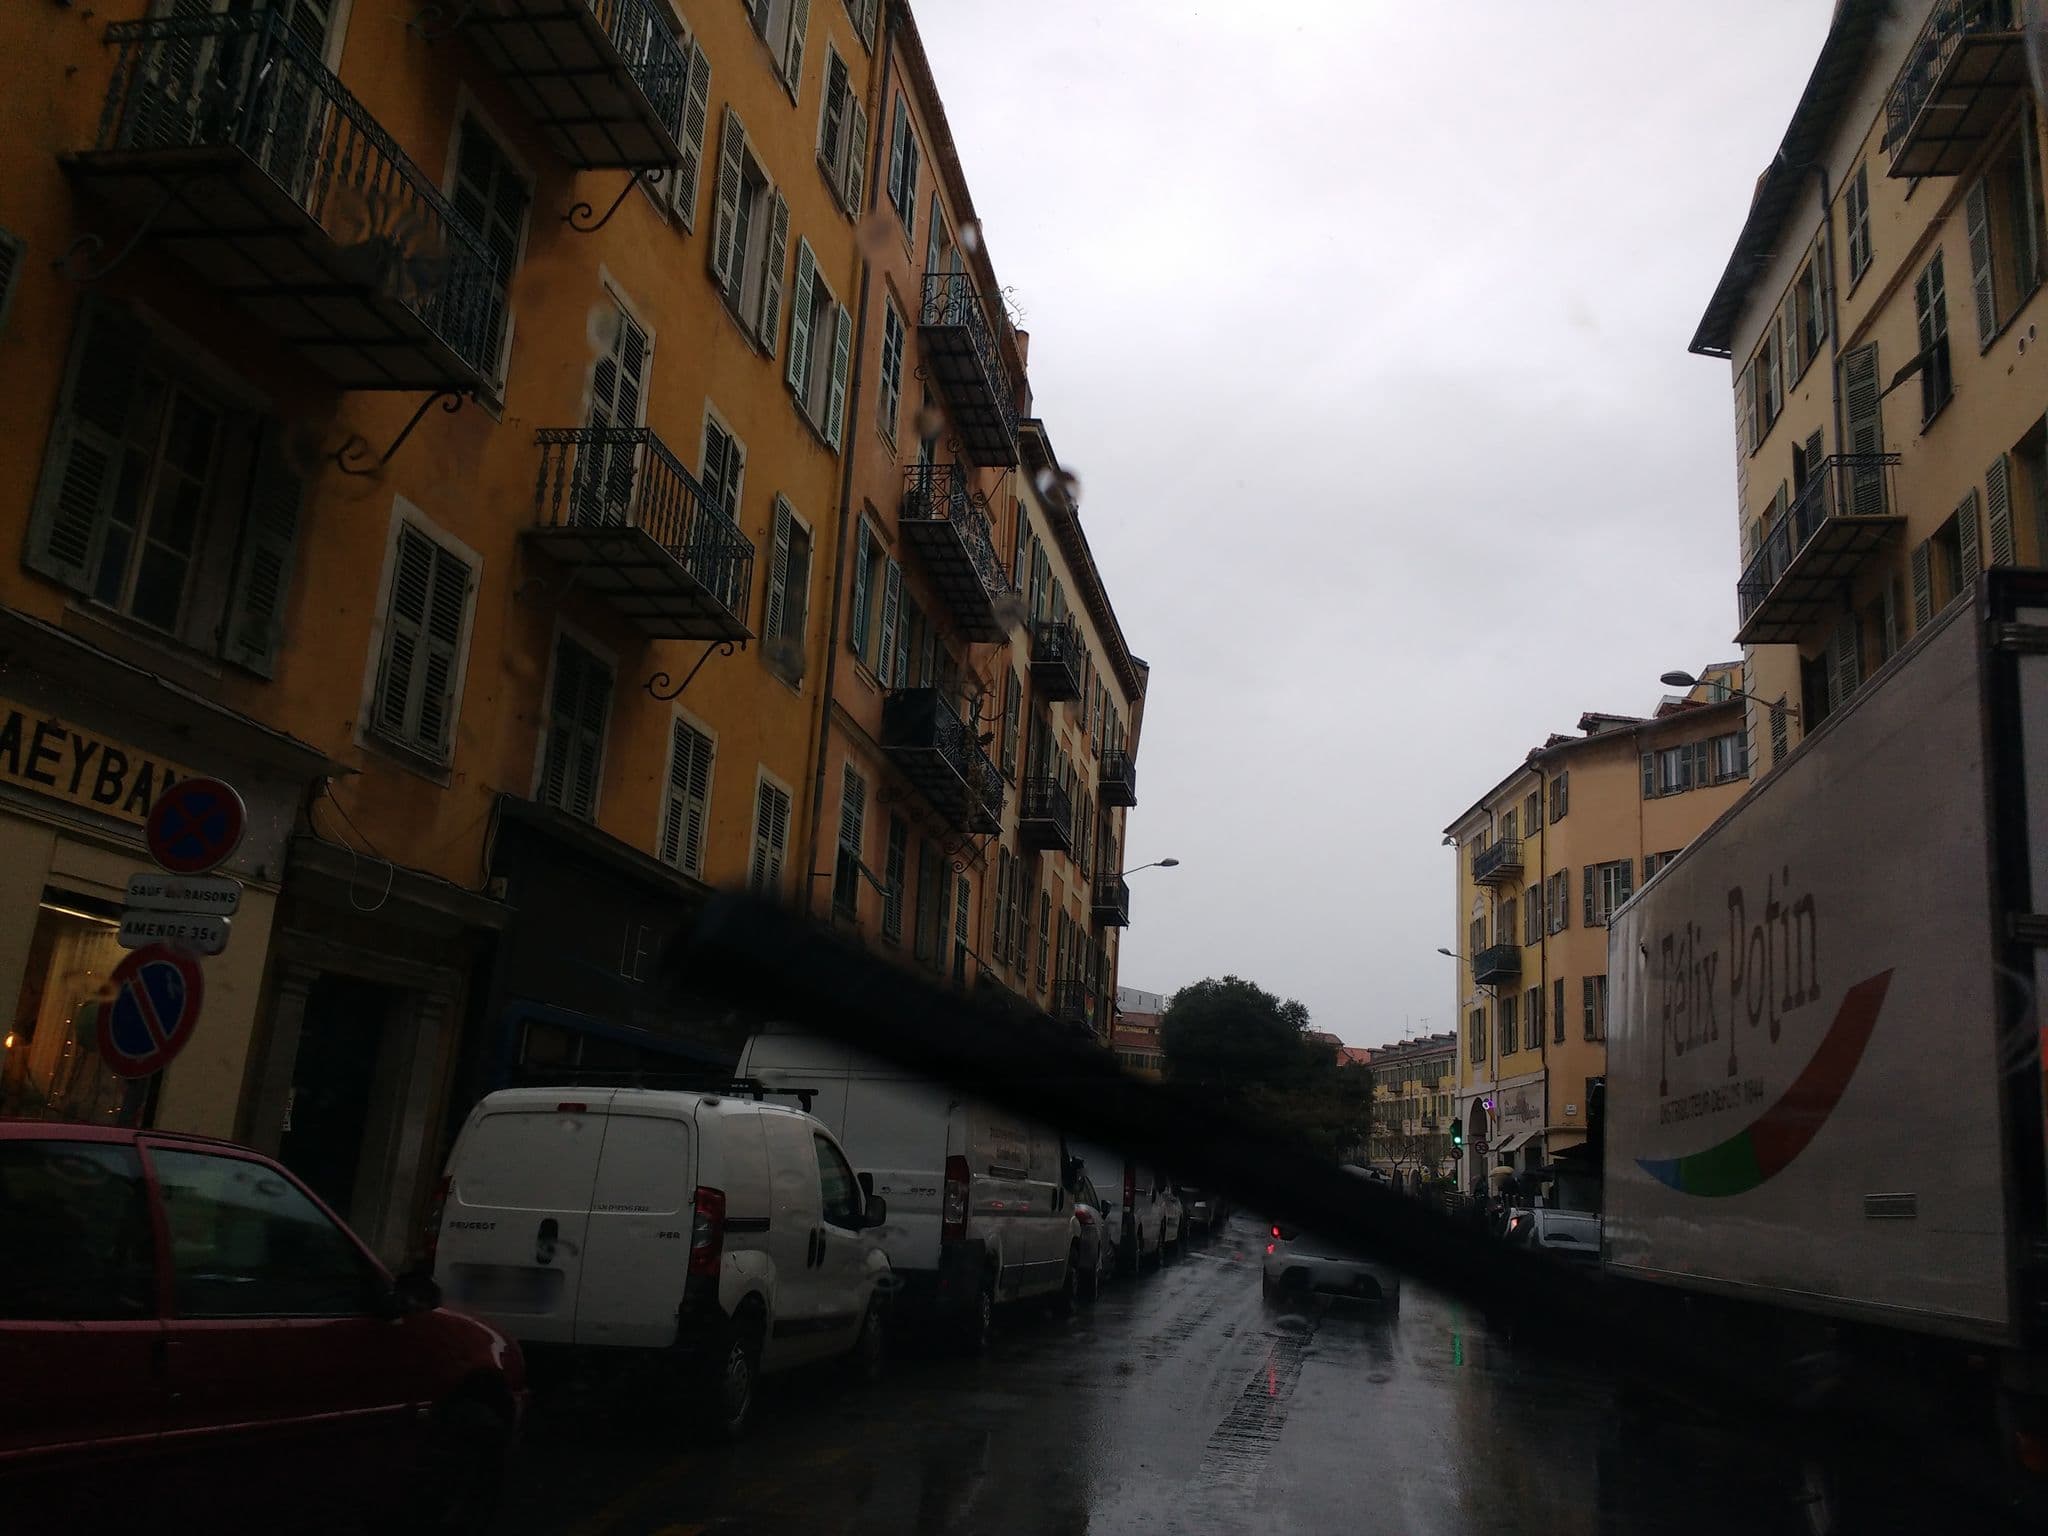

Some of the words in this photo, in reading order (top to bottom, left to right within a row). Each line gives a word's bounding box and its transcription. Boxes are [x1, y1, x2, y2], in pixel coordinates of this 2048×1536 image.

[130, 884, 163, 897] SAUF
[124, 922, 187, 939] AMENDE
[1727, 865, 1821, 1077] Potin
[449, 1221, 497, 1231] PEUGEOT
